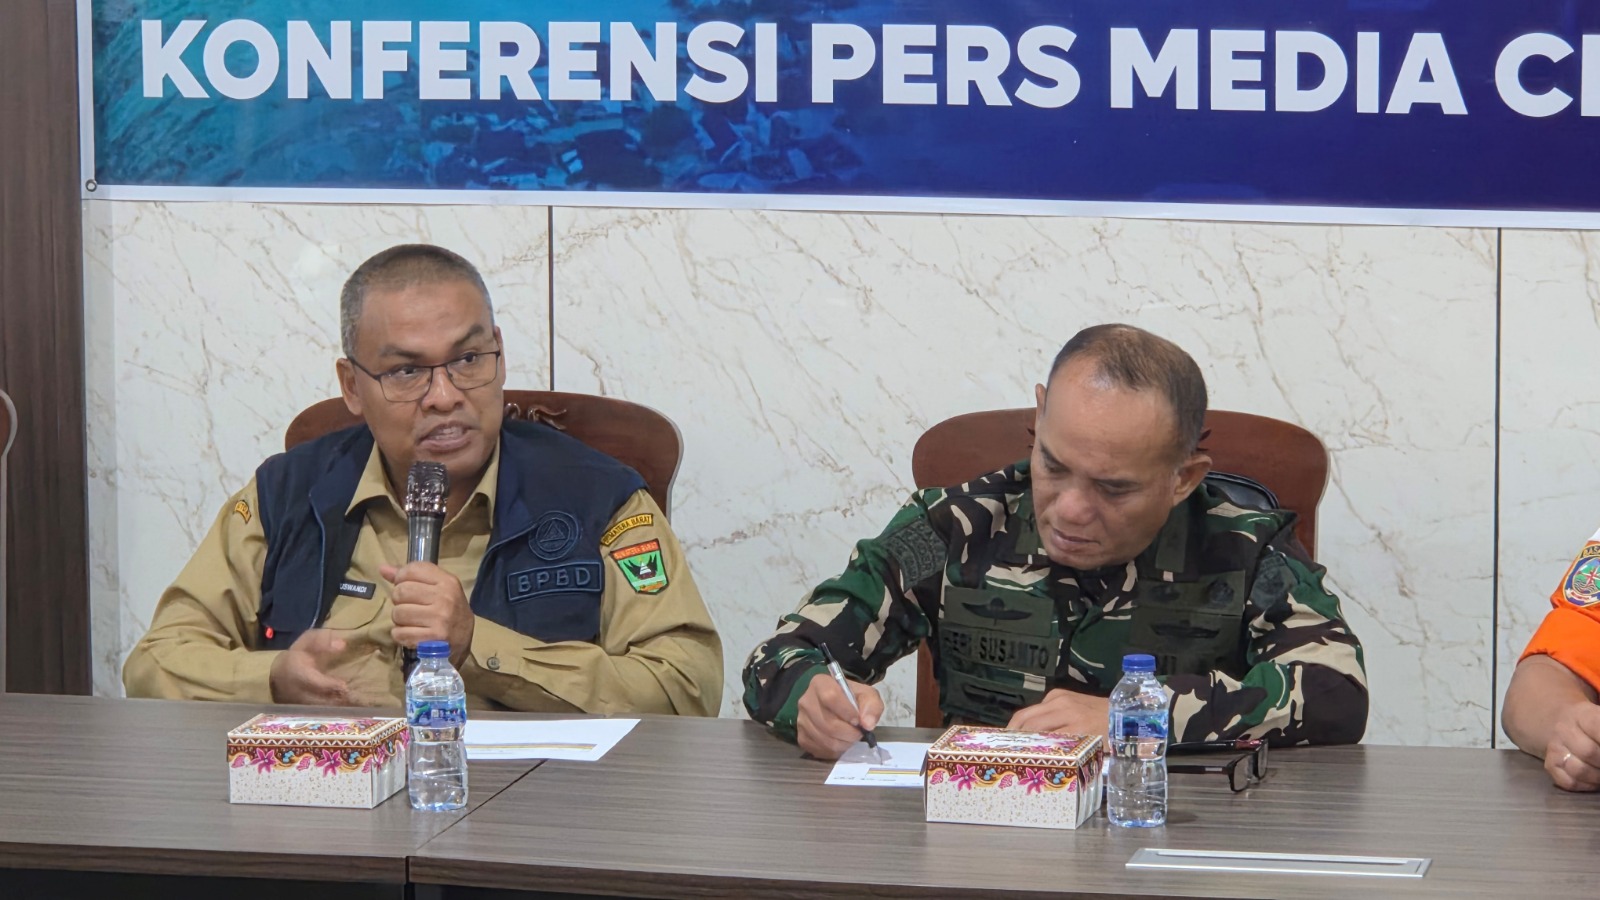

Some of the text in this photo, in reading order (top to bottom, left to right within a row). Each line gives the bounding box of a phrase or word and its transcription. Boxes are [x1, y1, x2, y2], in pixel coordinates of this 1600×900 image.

[141, 19, 778, 103] KONFERENSI
[811, 24, 1081, 108] PERS
[1110, 28, 1468, 115] MEDIA
[518, 567, 591, 593] BPBD
